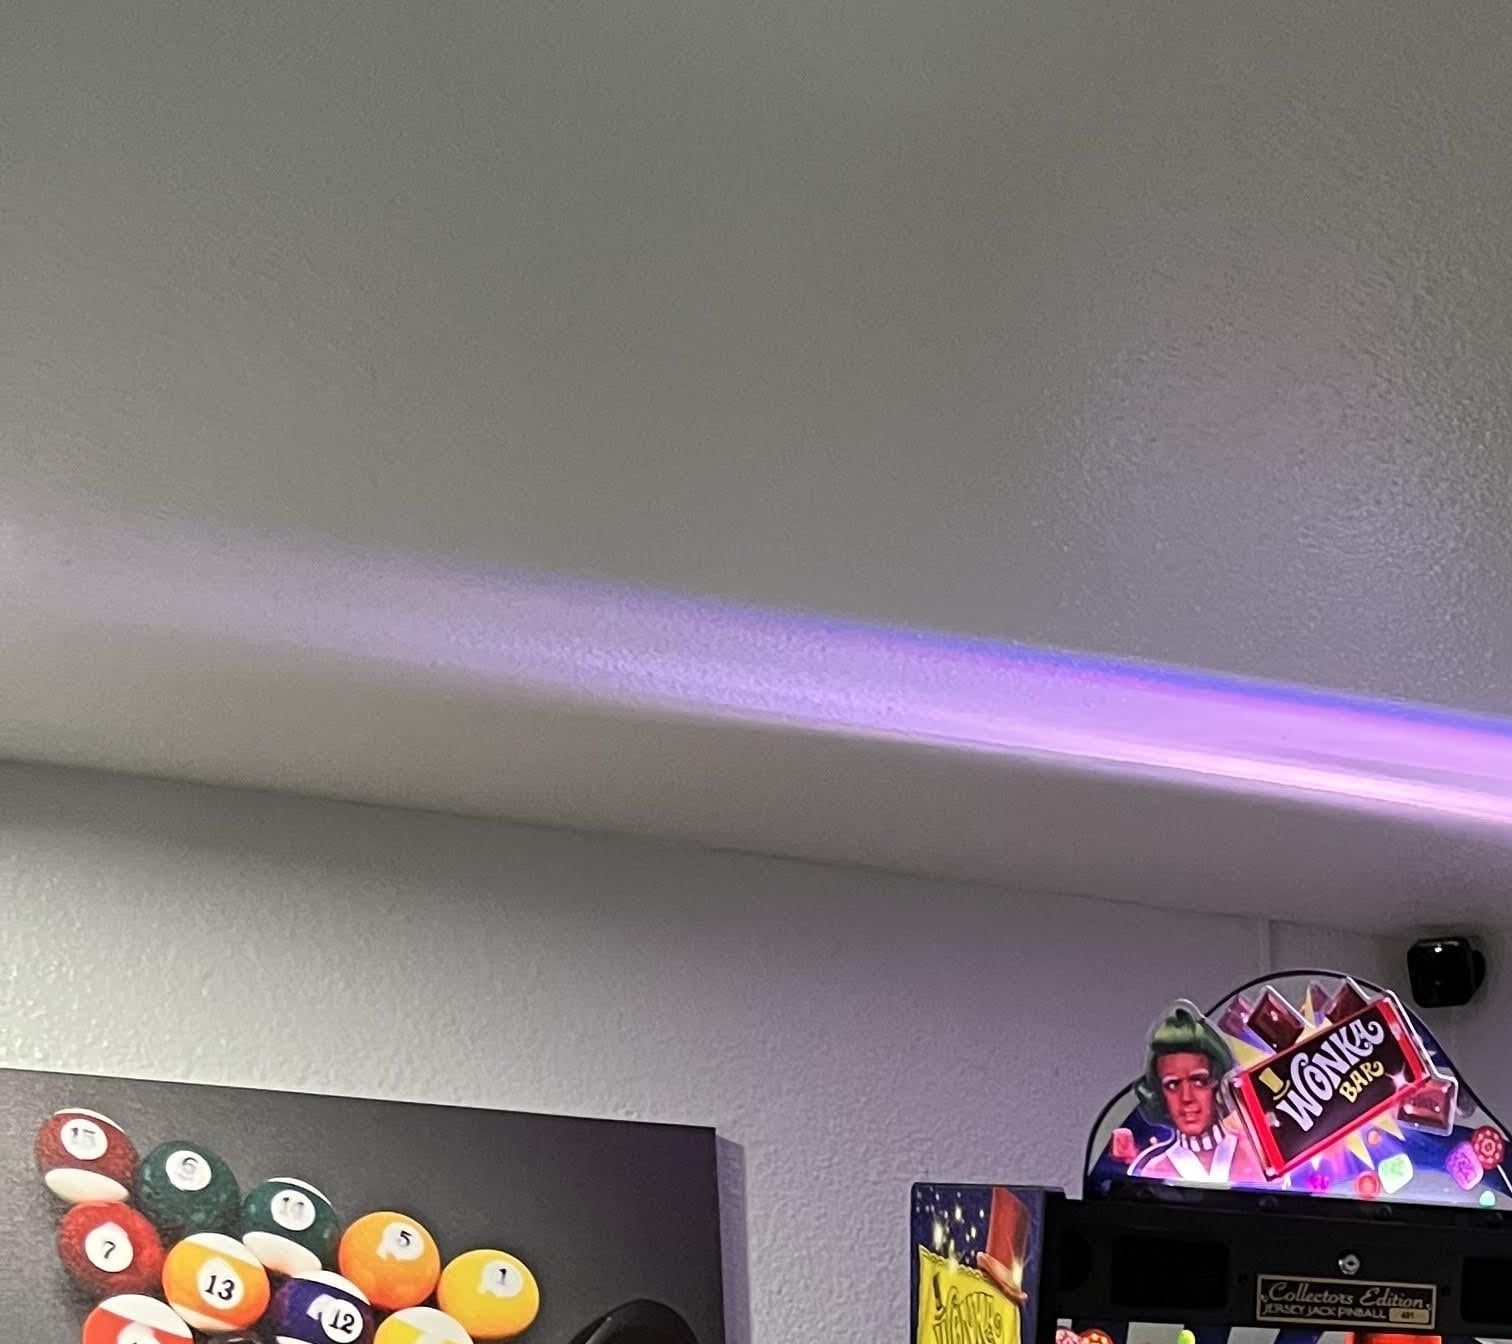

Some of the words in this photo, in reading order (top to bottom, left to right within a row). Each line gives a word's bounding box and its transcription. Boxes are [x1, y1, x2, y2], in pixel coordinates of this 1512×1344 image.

[1276, 1019, 1384, 1132] WONKA
[1339, 1061, 1384, 1103] BAR
[103, 1241, 117, 1259] 7
[398, 1230, 412, 1248] 5
[204, 1275, 235, 1301] 13
[498, 1268, 508, 1286] 1
[1268, 1282, 1354, 1305] Collectors
[1359, 1287, 1424, 1308] Edition
[1263, 1303, 1304, 1315] JERSEY
[1305, 1305, 1335, 1317] JACK
[1338, 1307, 1386, 1319] PINBALL
[329, 1312, 355, 1334] 12
